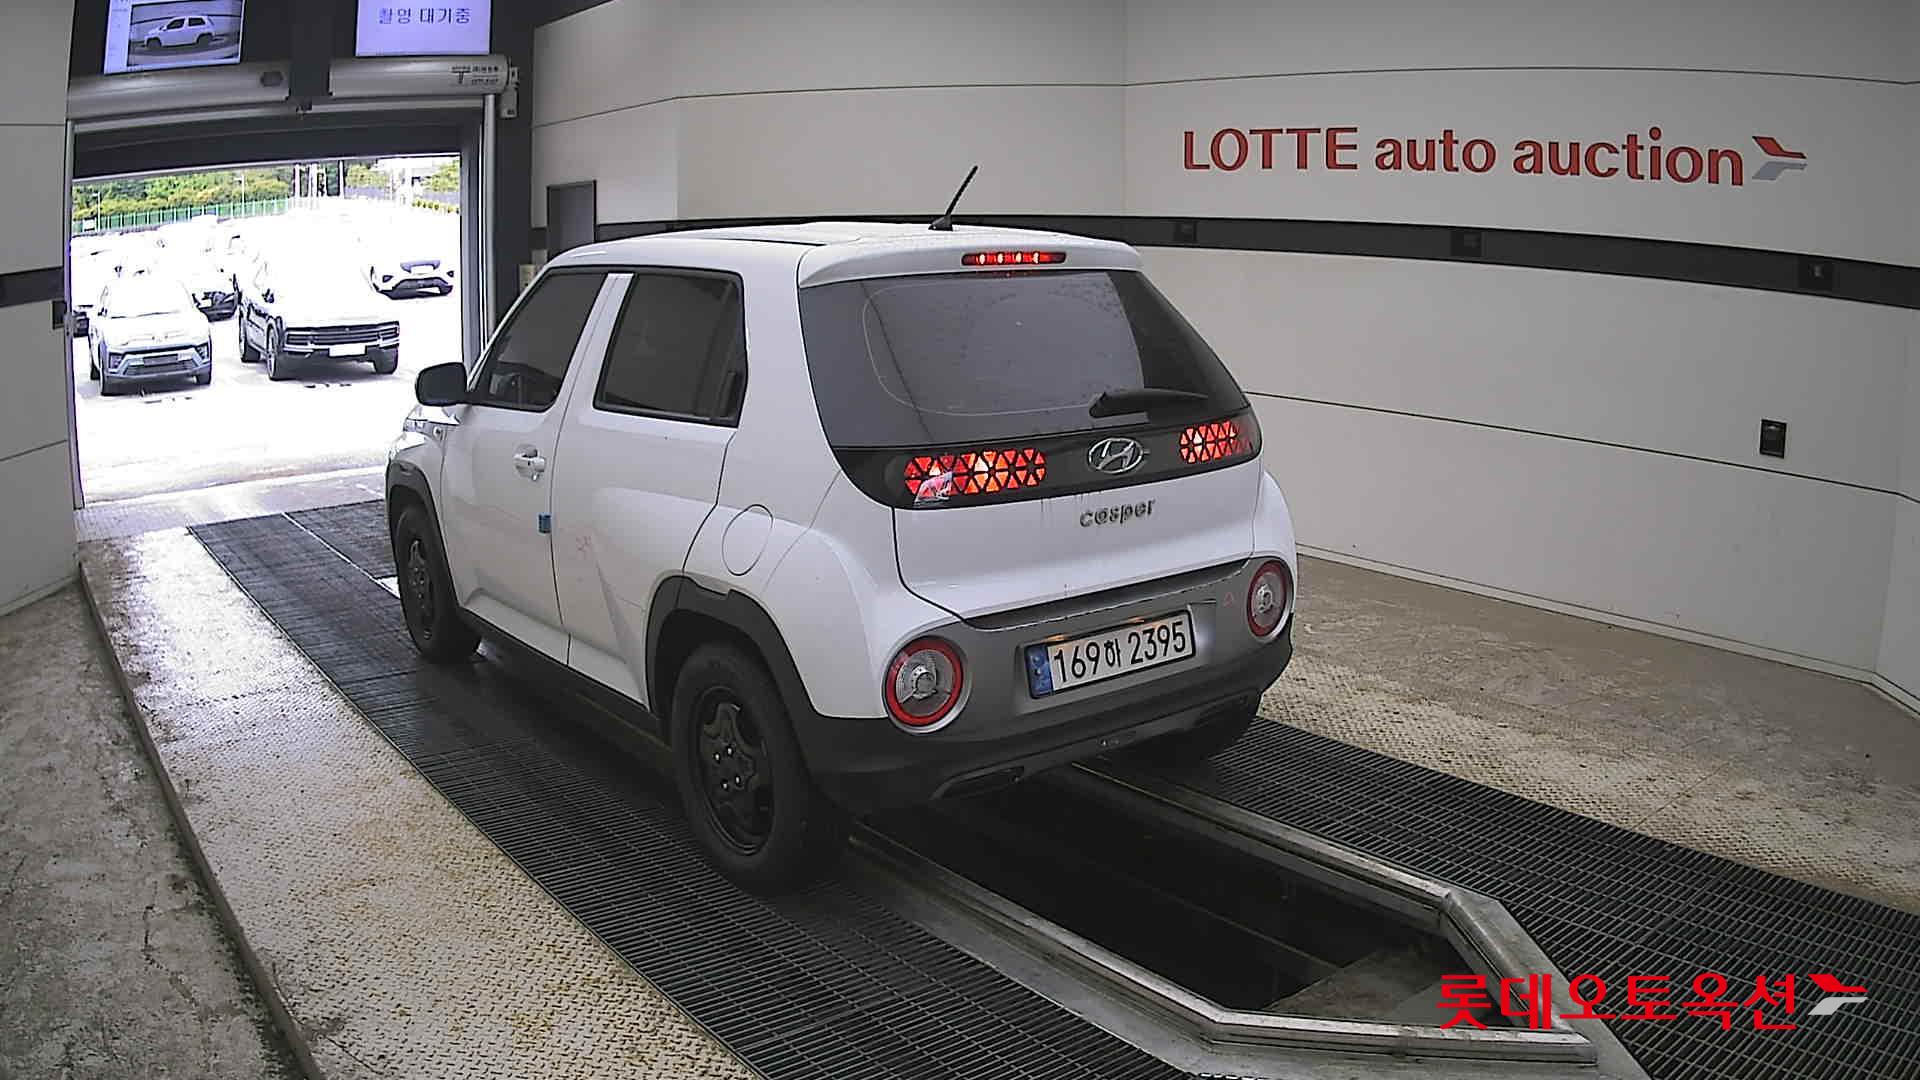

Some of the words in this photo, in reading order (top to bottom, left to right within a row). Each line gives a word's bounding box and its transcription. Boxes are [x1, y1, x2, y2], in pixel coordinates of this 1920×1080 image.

[420, 7, 471, 24] 대기중
[1184, 127, 1358, 171] LOTTE
[1374, 129, 1497, 173] auto
[1512, 127, 1743, 186] auction
[1080, 499, 1156, 527] casper
[1128, 621, 1186, 665] 2395
